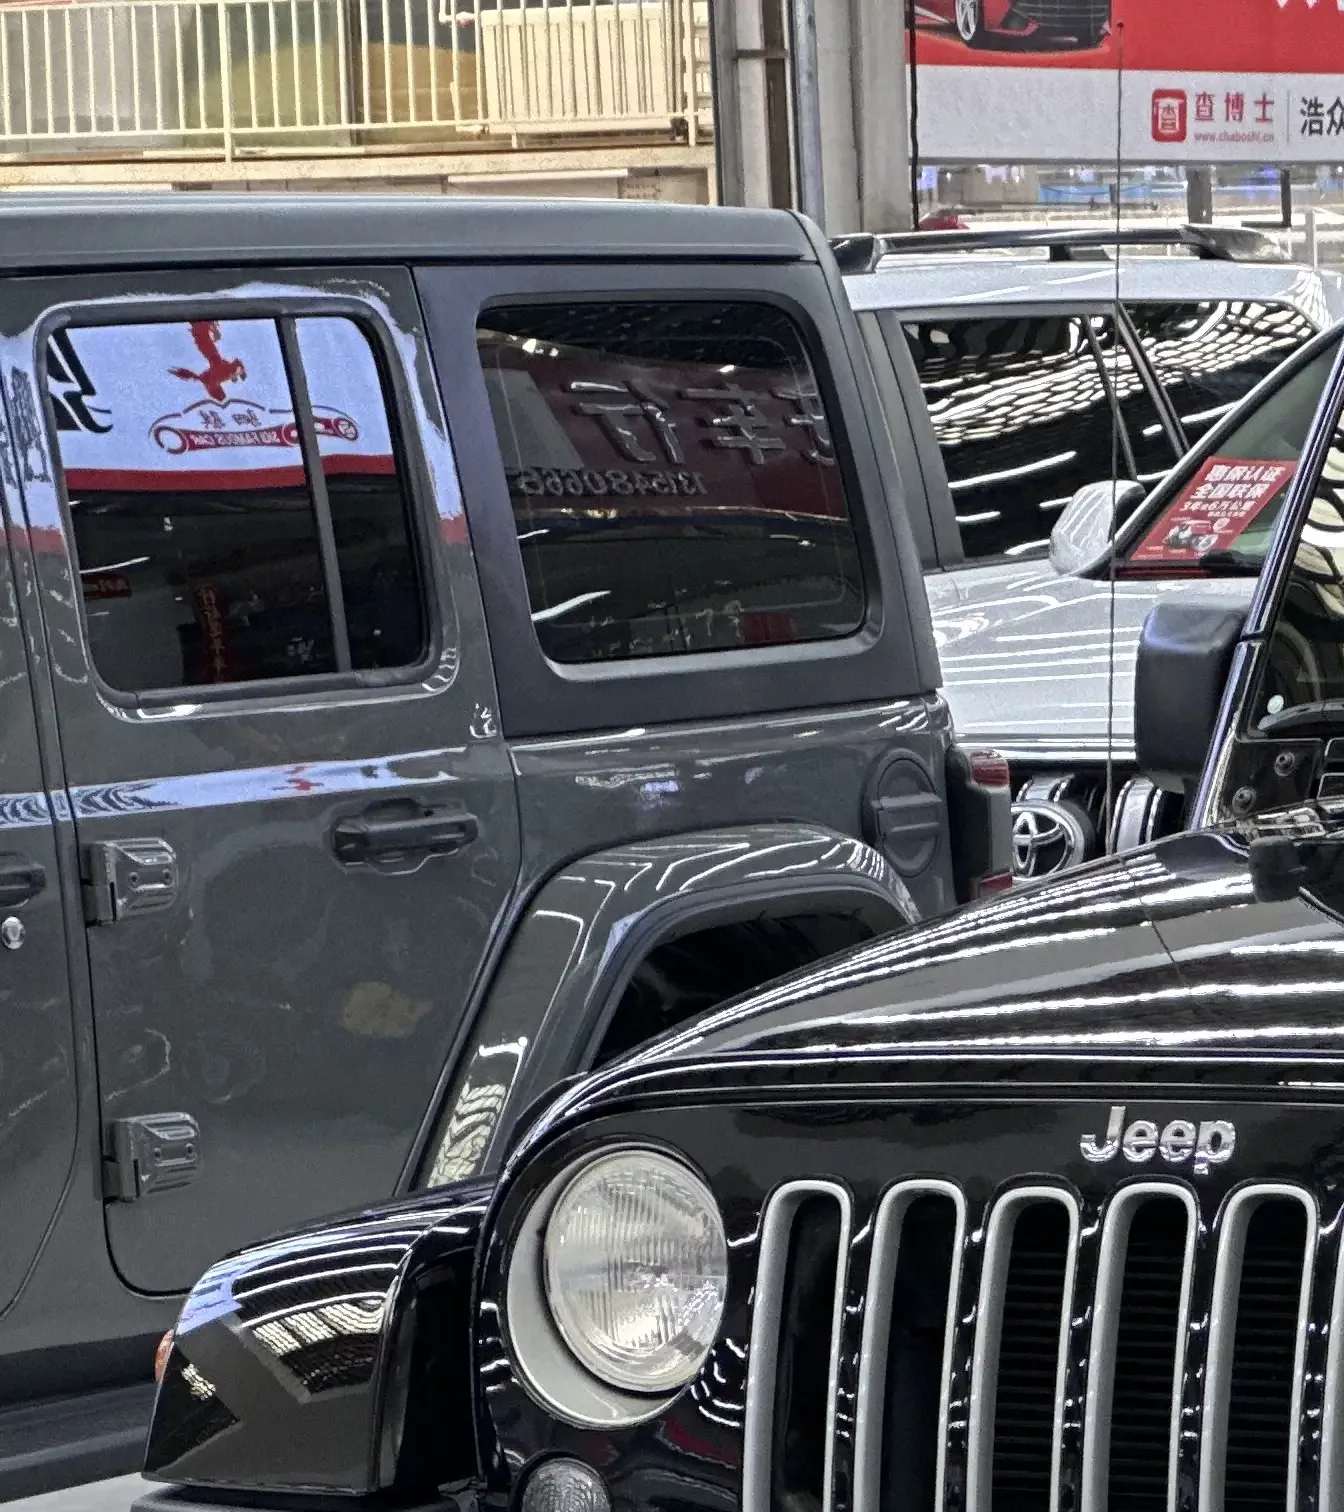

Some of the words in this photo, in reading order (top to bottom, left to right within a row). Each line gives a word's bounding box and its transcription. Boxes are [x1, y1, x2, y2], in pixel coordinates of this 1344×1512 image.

[1195, 92, 1275, 124] 查博士
[1080, 1106, 1236, 1175] Jeep
